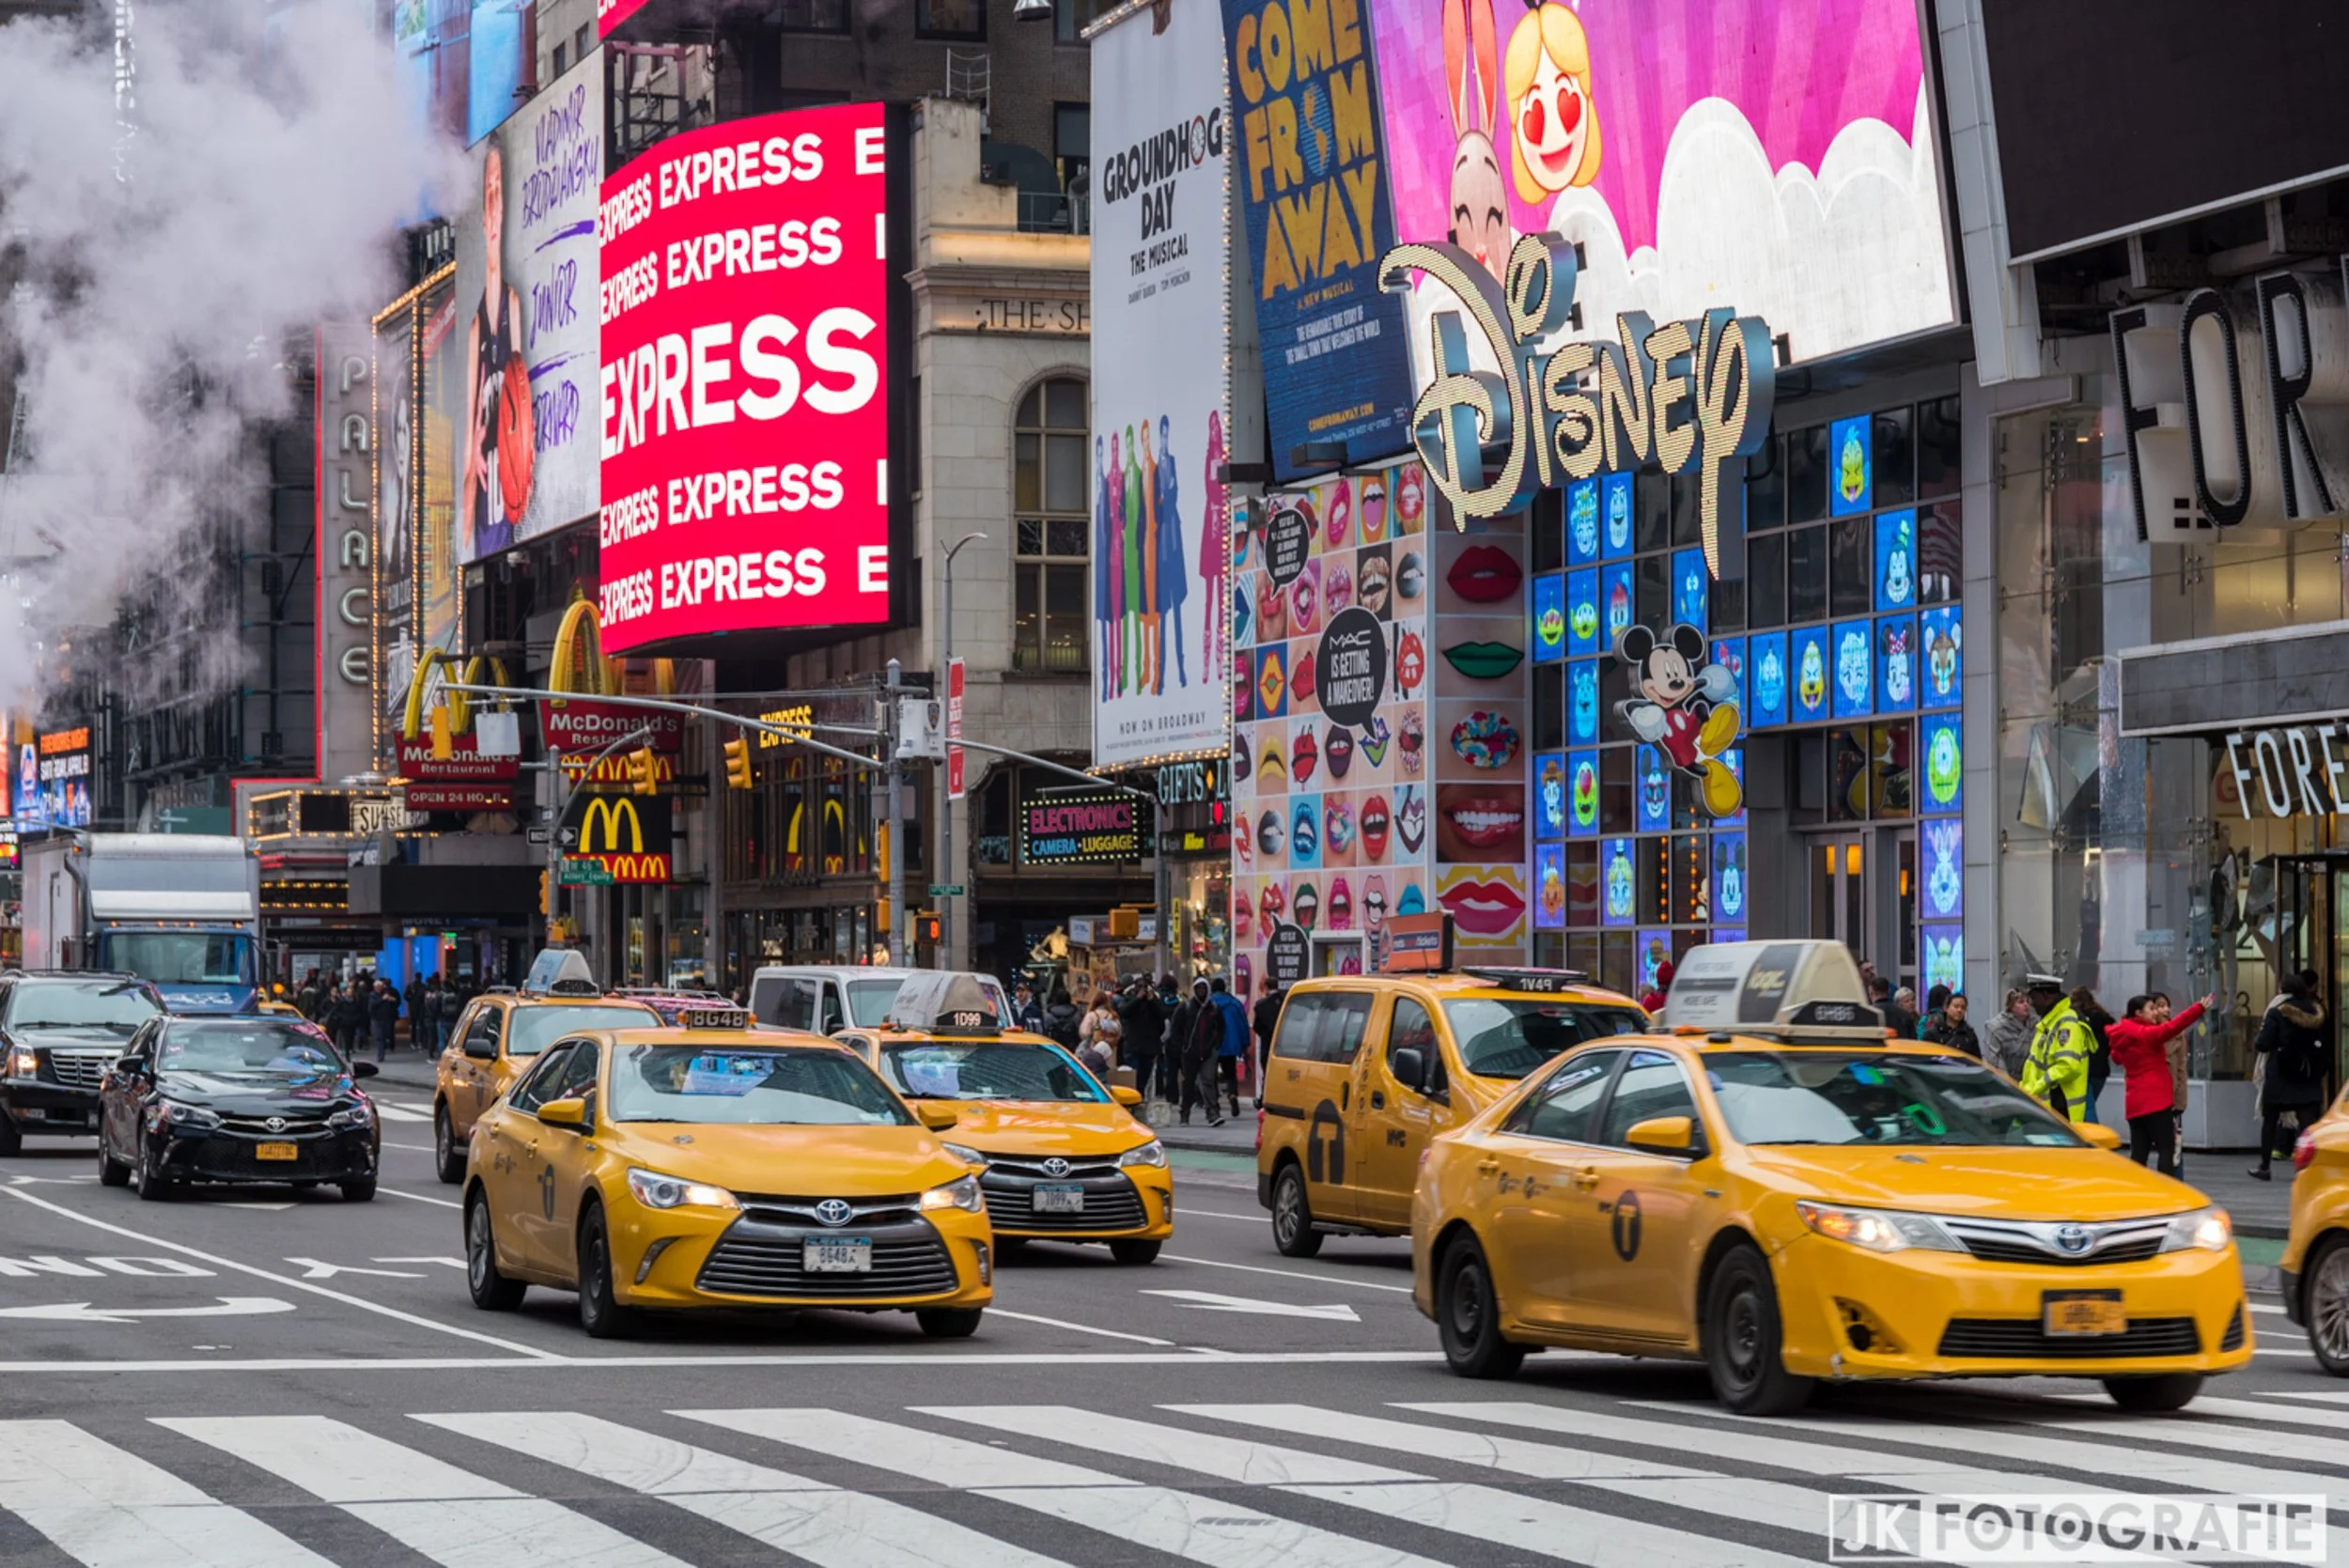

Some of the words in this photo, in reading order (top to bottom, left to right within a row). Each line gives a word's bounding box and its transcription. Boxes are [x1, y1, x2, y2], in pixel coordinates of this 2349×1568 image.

[1237, 0, 1361, 104] COME
[660, 132, 824, 210] EXPRESS
[1103, 106, 1221, 205] GROUNDHOG
[1141, 180, 1175, 241] DAY
[1262, 159, 1377, 301] AWAY
[599, 251, 658, 325] EXPRESS
[667, 215, 843, 290] EXPRESS
[1130, 251, 1145, 277] THE
[1148, 233, 1189, 271] MUSICAL
[529, 258, 577, 349] JUNIOR
[981, 300, 1046, 330] THE
[1322, 282, 1354, 302] MUSICAL
[599, 306, 879, 462] EXPRESS
[2108, 256, 2349, 545] FOR
[533, 379, 580, 454] ORWARD
[339, 355, 369, 684] PALACE
[599, 485, 660, 550] EXPRESS
[668, 460, 845, 526] EXPRESS
[661, 547, 826, 610] EXPRESS
[1330, 653, 1339, 678] IS
[1340, 648, 1370, 676] GETTING
[1332, 676, 1374, 706] MAKEOVER!
[550, 713, 678, 732] McDonald's
[1119, 721, 1137, 735] NOW
[1143, 718, 1153, 731] ON
[1159, 711, 1206, 730] BROADWAY
[421, 763, 497, 775] Restaurant
[1158, 761, 1205, 805] GIFTS
[2225, 723, 2349, 820] FORE
[411, 792, 444, 804] OPEN
[448, 792, 463, 804] 24
[466, 792, 509, 805] HOR
[1030, 802, 1132, 834] ELECTRONICS
[1032, 838, 1077, 857] CAMERA
[1081, 834, 1133, 852] LUGGAGE
[693, 1011, 745, 1028] 8G48
[954, 1012, 981, 1027] 1D99
